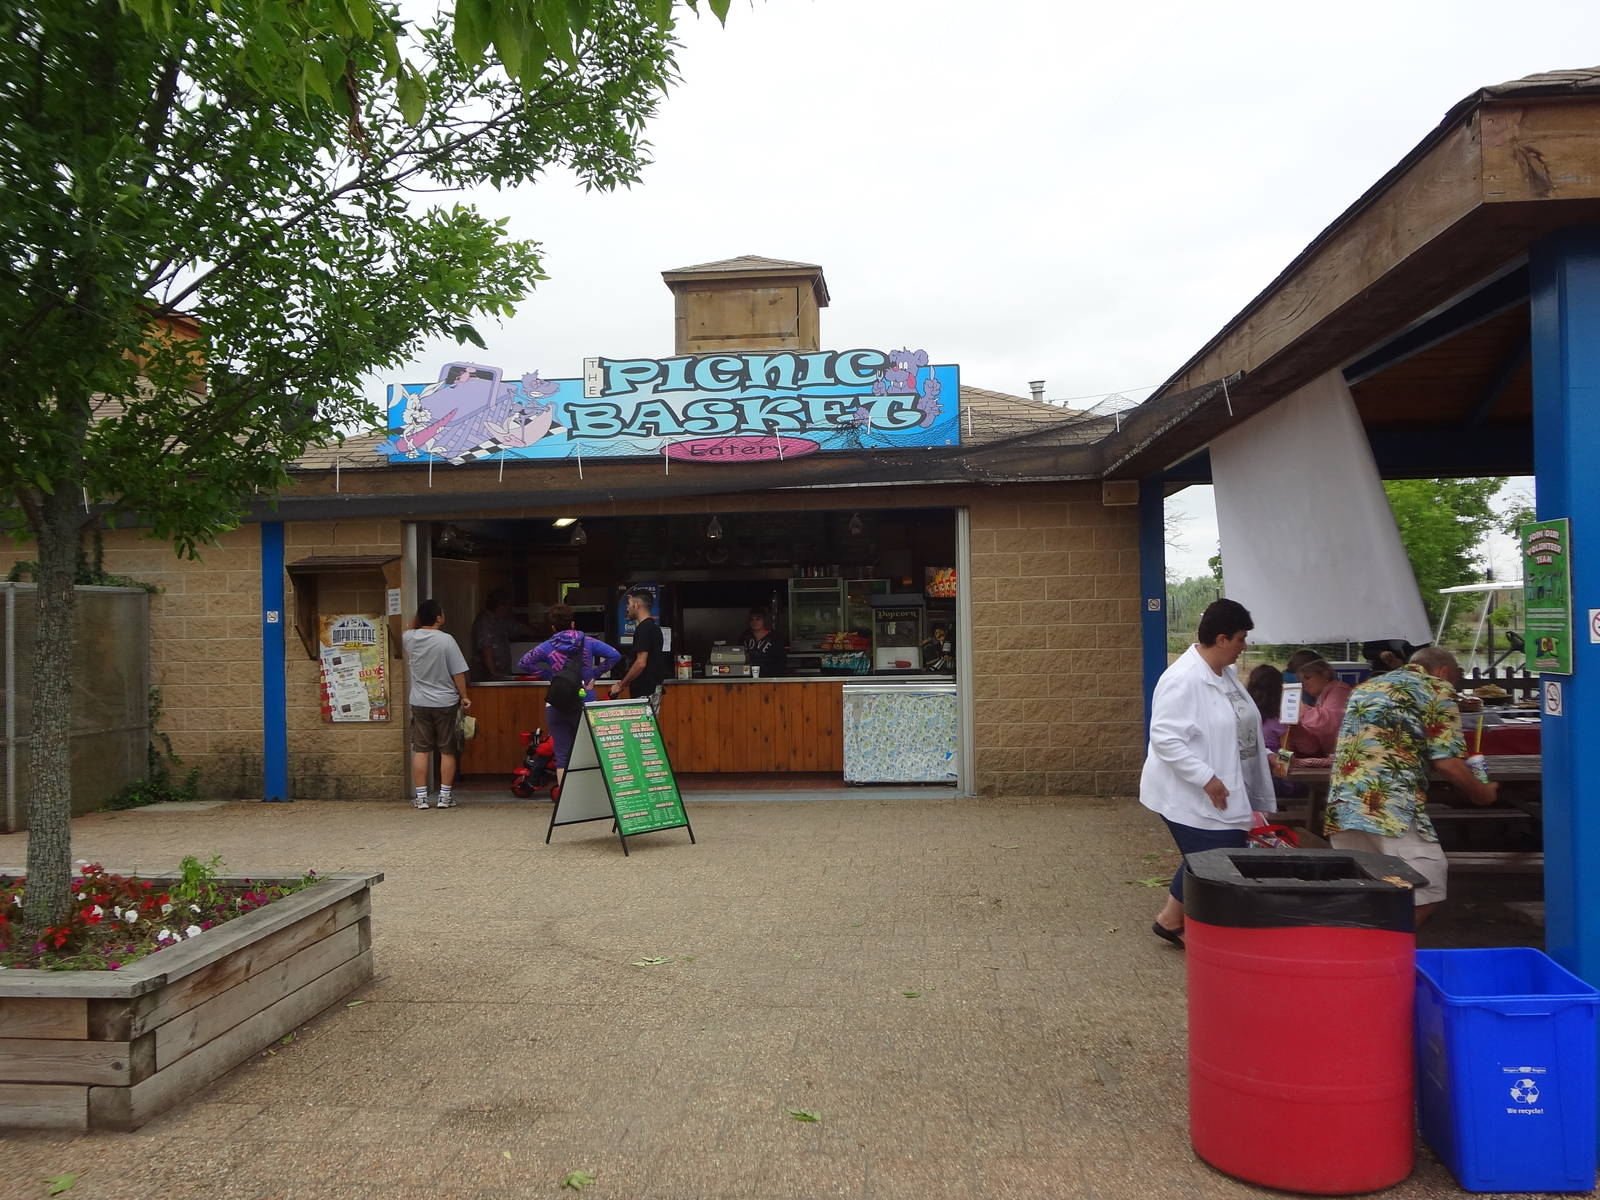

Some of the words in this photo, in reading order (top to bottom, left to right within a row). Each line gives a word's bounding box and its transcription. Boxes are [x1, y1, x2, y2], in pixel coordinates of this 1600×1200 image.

[588, 360, 597, 395] THE
[599, 349, 889, 396] PICNIC
[565, 393, 926, 440] BASKET
[690, 443, 789, 460] Eatery
[1528, 532, 1543, 543] JOIN
[1545, 529, 1560, 540] OUR
[1527, 542, 1562, 556] VOLUNTEER
[1536, 555, 1553, 565] TEAM
[877, 609, 919, 619] Popcorn
